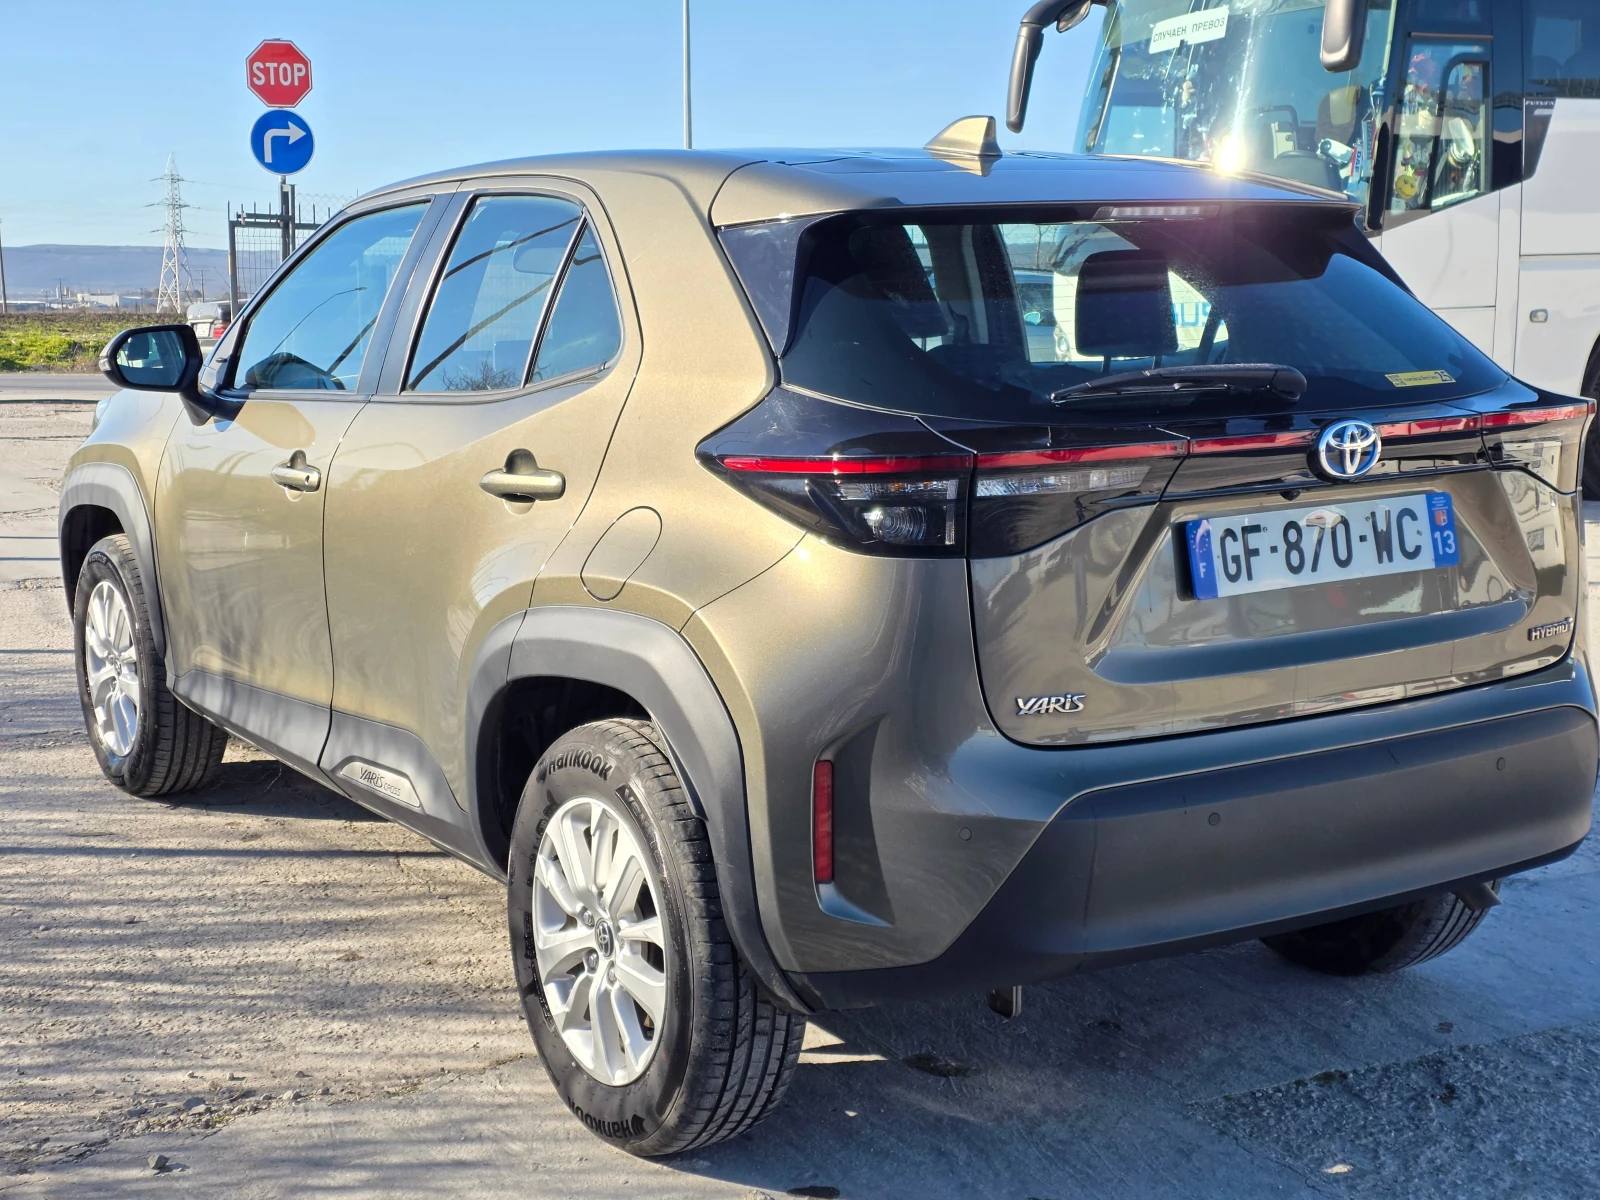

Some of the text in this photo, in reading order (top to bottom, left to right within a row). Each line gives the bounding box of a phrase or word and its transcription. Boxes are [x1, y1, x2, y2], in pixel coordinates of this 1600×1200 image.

[1153, 18, 1226, 42] СЛУЧАЕН ПРЕВОЗ
[252, 61, 306, 86] STOP
[1220, 508, 1422, 583] GF-870-WC
[1434, 530, 1456, 555] 13
[1199, 562, 1207, 579] F
[1528, 621, 1568, 641] HYBRID
